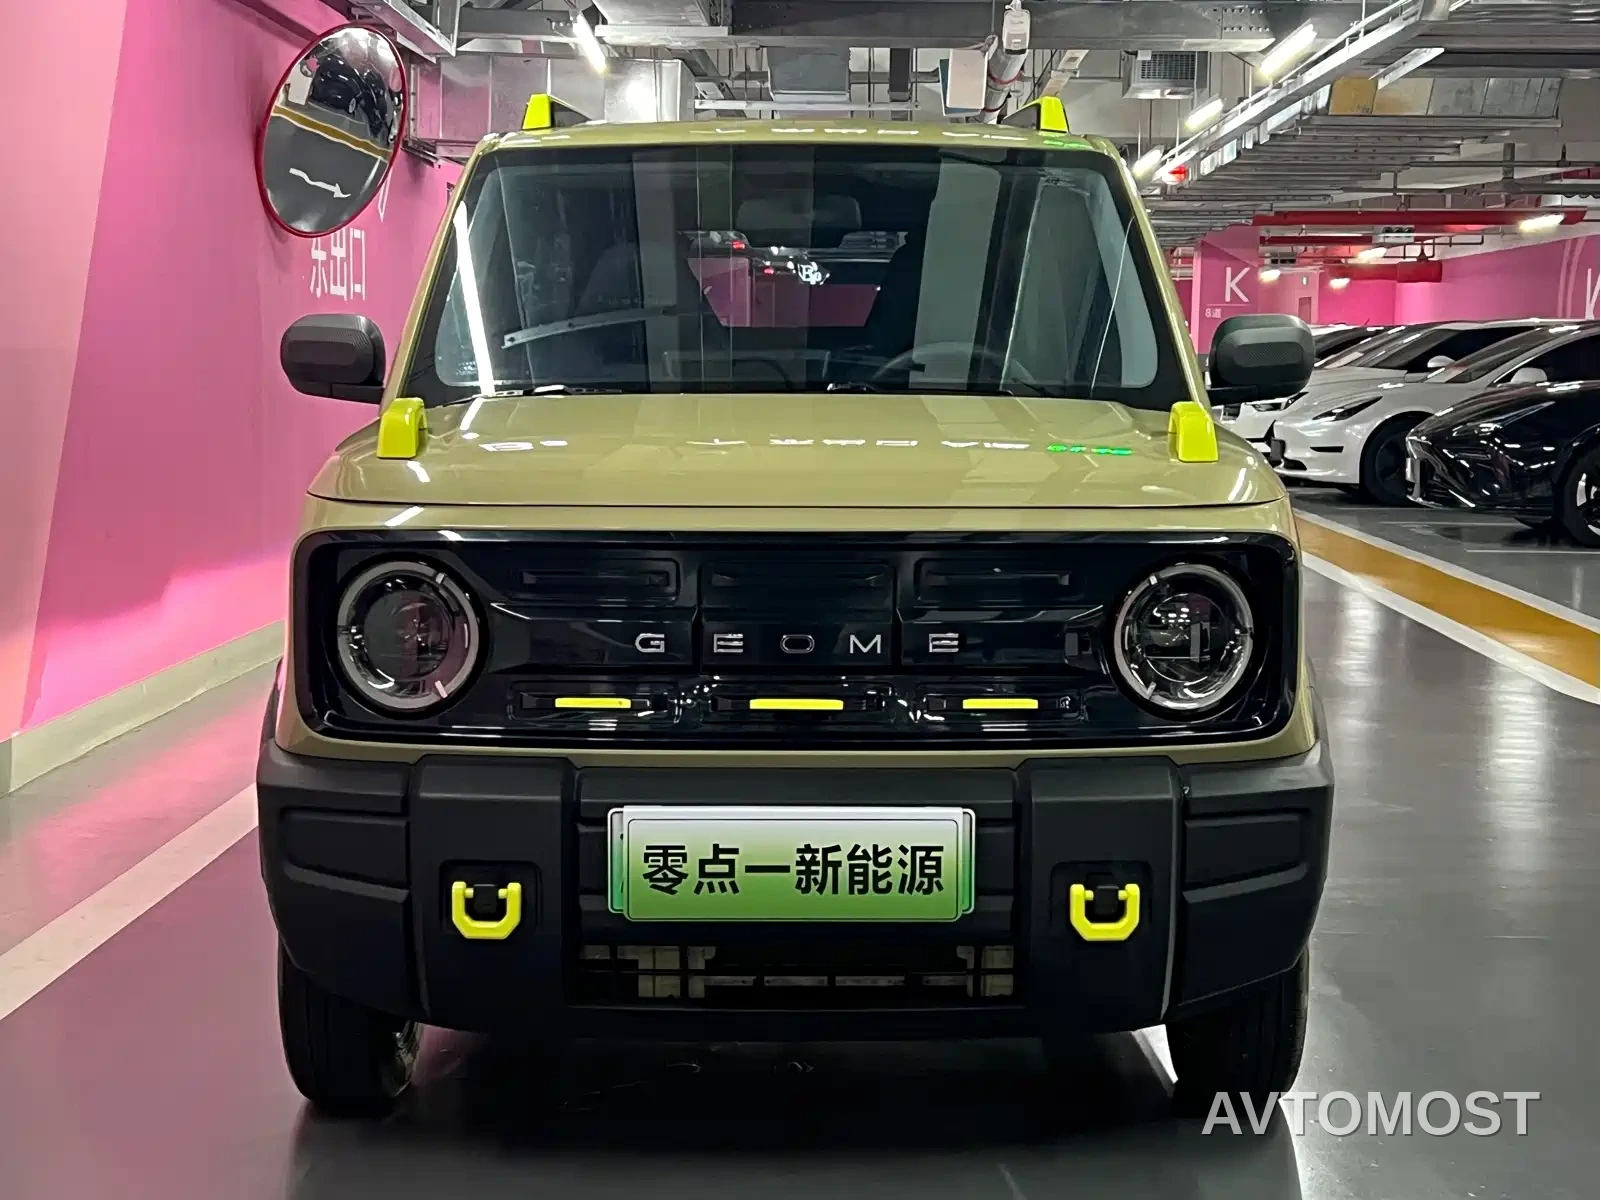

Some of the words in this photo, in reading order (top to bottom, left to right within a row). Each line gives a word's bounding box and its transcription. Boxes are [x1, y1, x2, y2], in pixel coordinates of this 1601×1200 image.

[1225, 267, 1251, 303] K
[635, 633, 959, 654] GEOME
[642, 843, 945, 896] 零点一新能源
